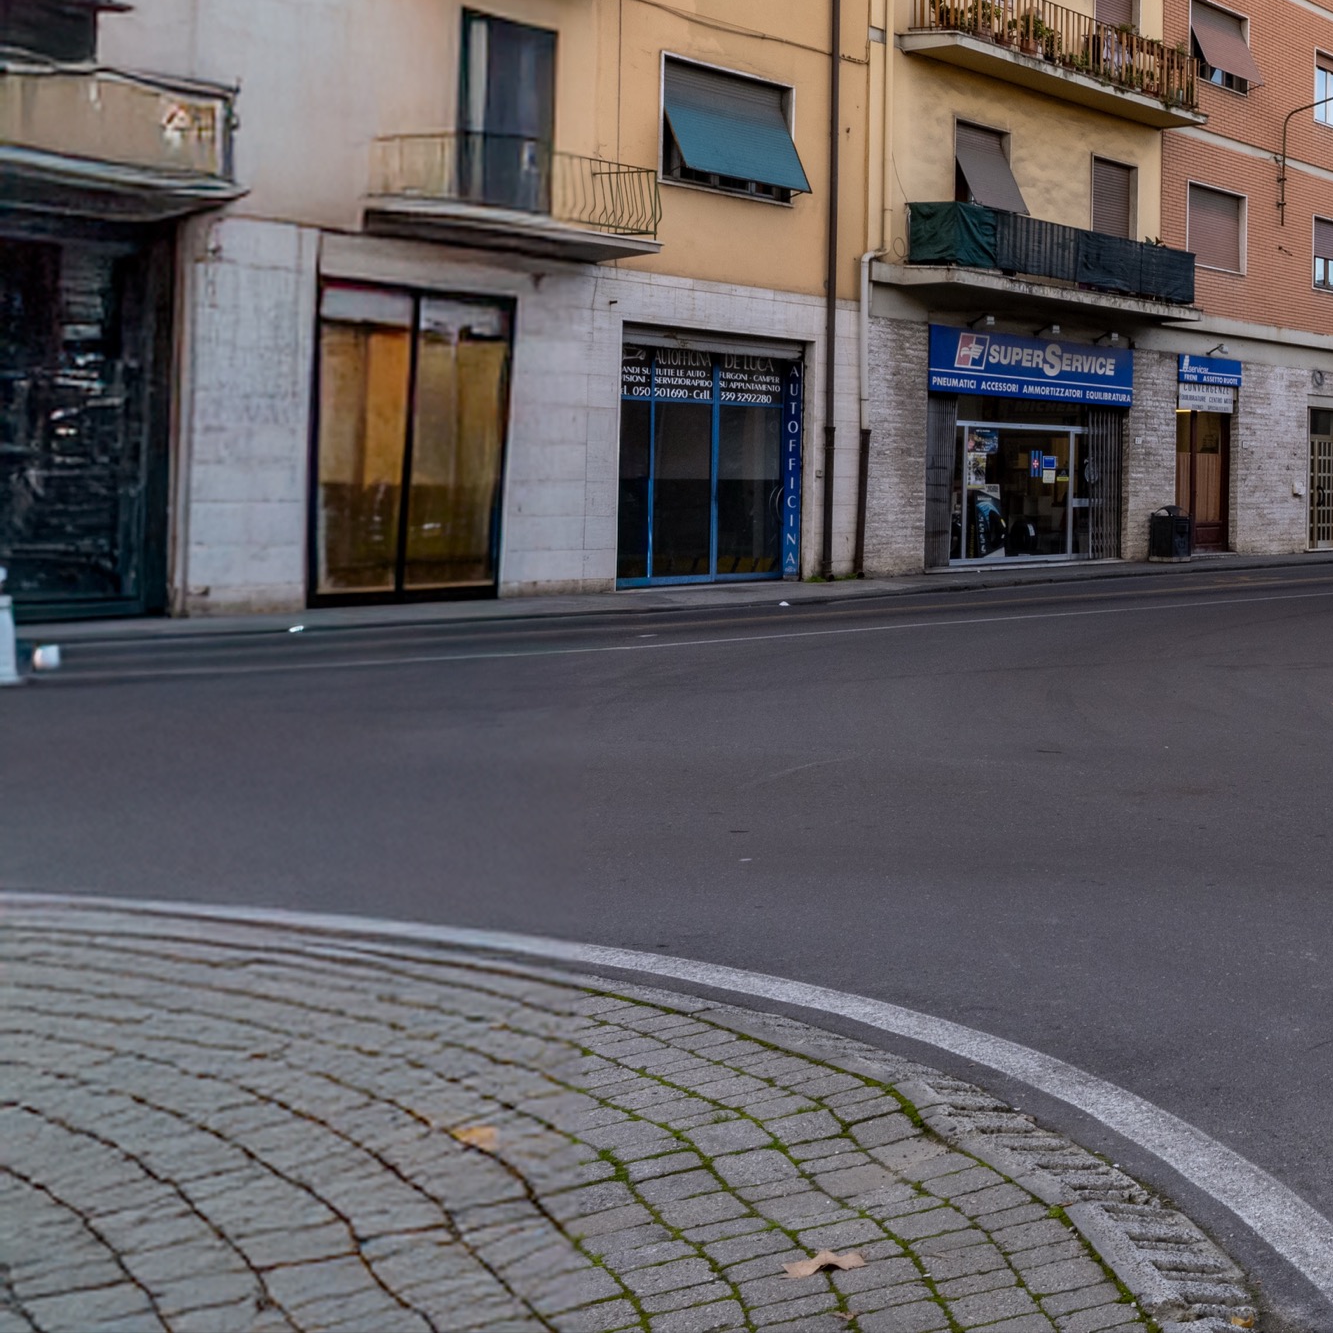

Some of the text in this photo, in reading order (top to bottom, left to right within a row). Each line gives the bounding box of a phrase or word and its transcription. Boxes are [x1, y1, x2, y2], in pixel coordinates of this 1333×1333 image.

[655, 348, 775, 373] AUTOFFICINA DE LUCA
[641, 367, 652, 375] SU
[655, 367, 675, 377] TUTTE
[676, 369, 685, 377] LE
[686, 370, 706, 378] AUTO
[719, 371, 748, 381] FURGONI
[753, 375, 780, 384] CAMPER
[1202, 375, 1223, 384] ASSETTO
[632, 385, 651, 397] 050
[654, 386, 688, 399] 501690
[720, 391, 736, 402] 339
[736, 392, 772, 404] 3292280
[728, 382, 781, 393] APPUNTAMENTO
[932, 376, 1131, 403] PNEUMATICI ACCESSORI AMMORTIZZATORI EQUILIBRATURA
[1183, 383, 1230, 395] CONVERGENZE
[786, 365, 799, 565] AUTOFFICINA
